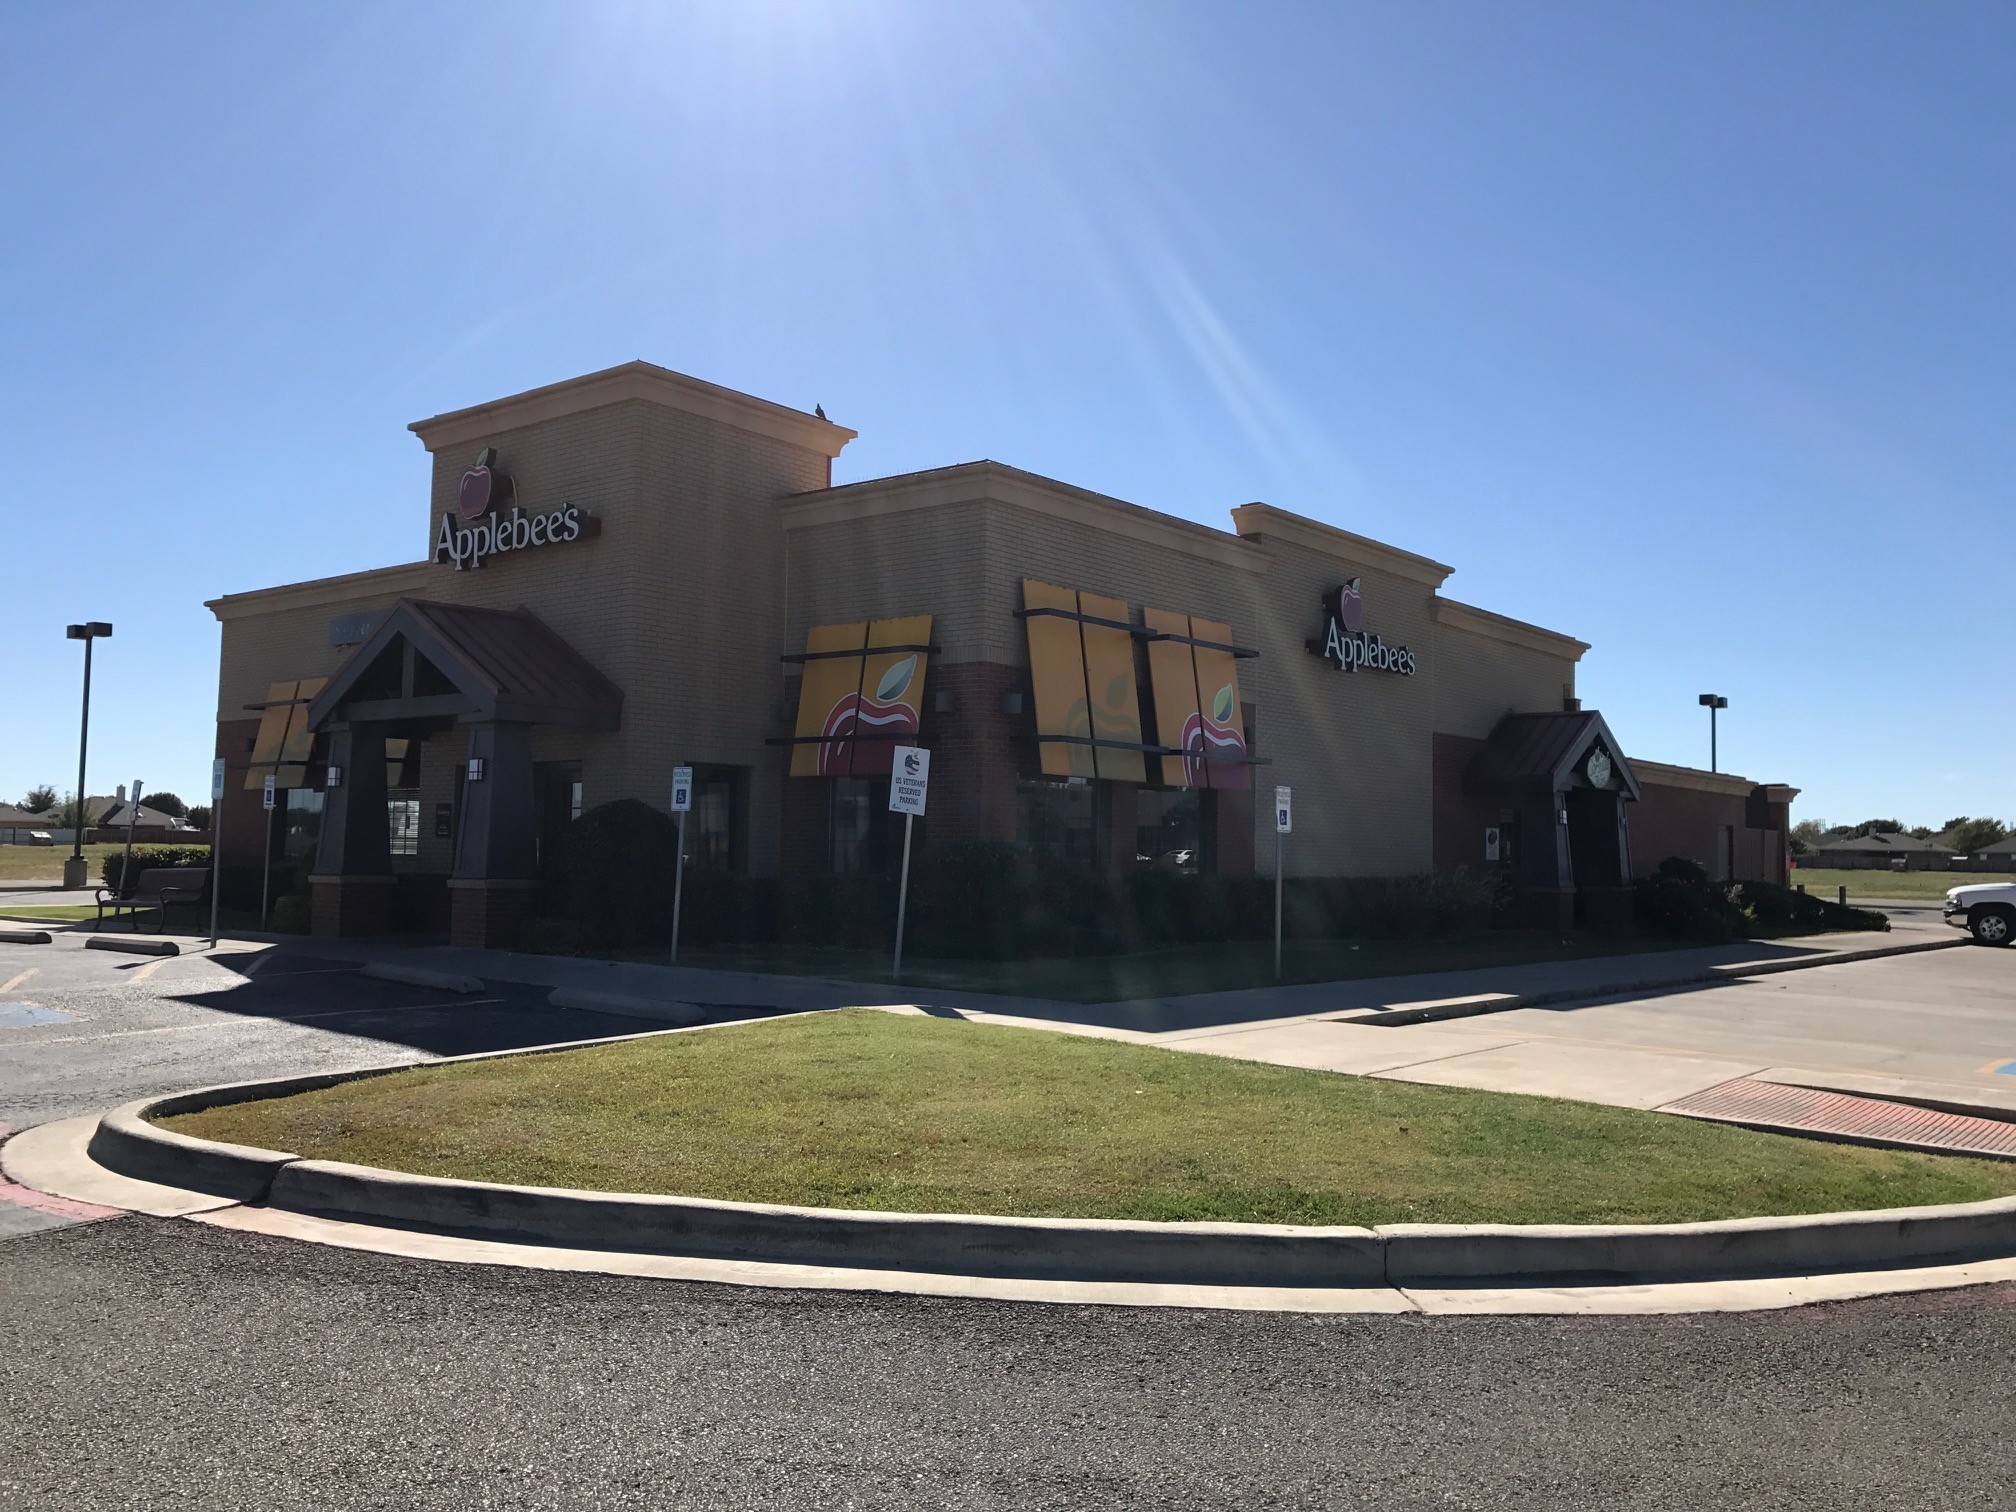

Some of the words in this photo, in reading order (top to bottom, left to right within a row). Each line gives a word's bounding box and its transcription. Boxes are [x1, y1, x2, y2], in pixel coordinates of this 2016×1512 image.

[432, 502, 580, 571] Applebee's
[1324, 616, 1416, 676] Applebee's
[896, 776, 902, 784] US
[903, 778, 926, 788] VETERANS
[898, 786, 921, 796] RESERVED
[900, 796, 918, 806] PARKING
